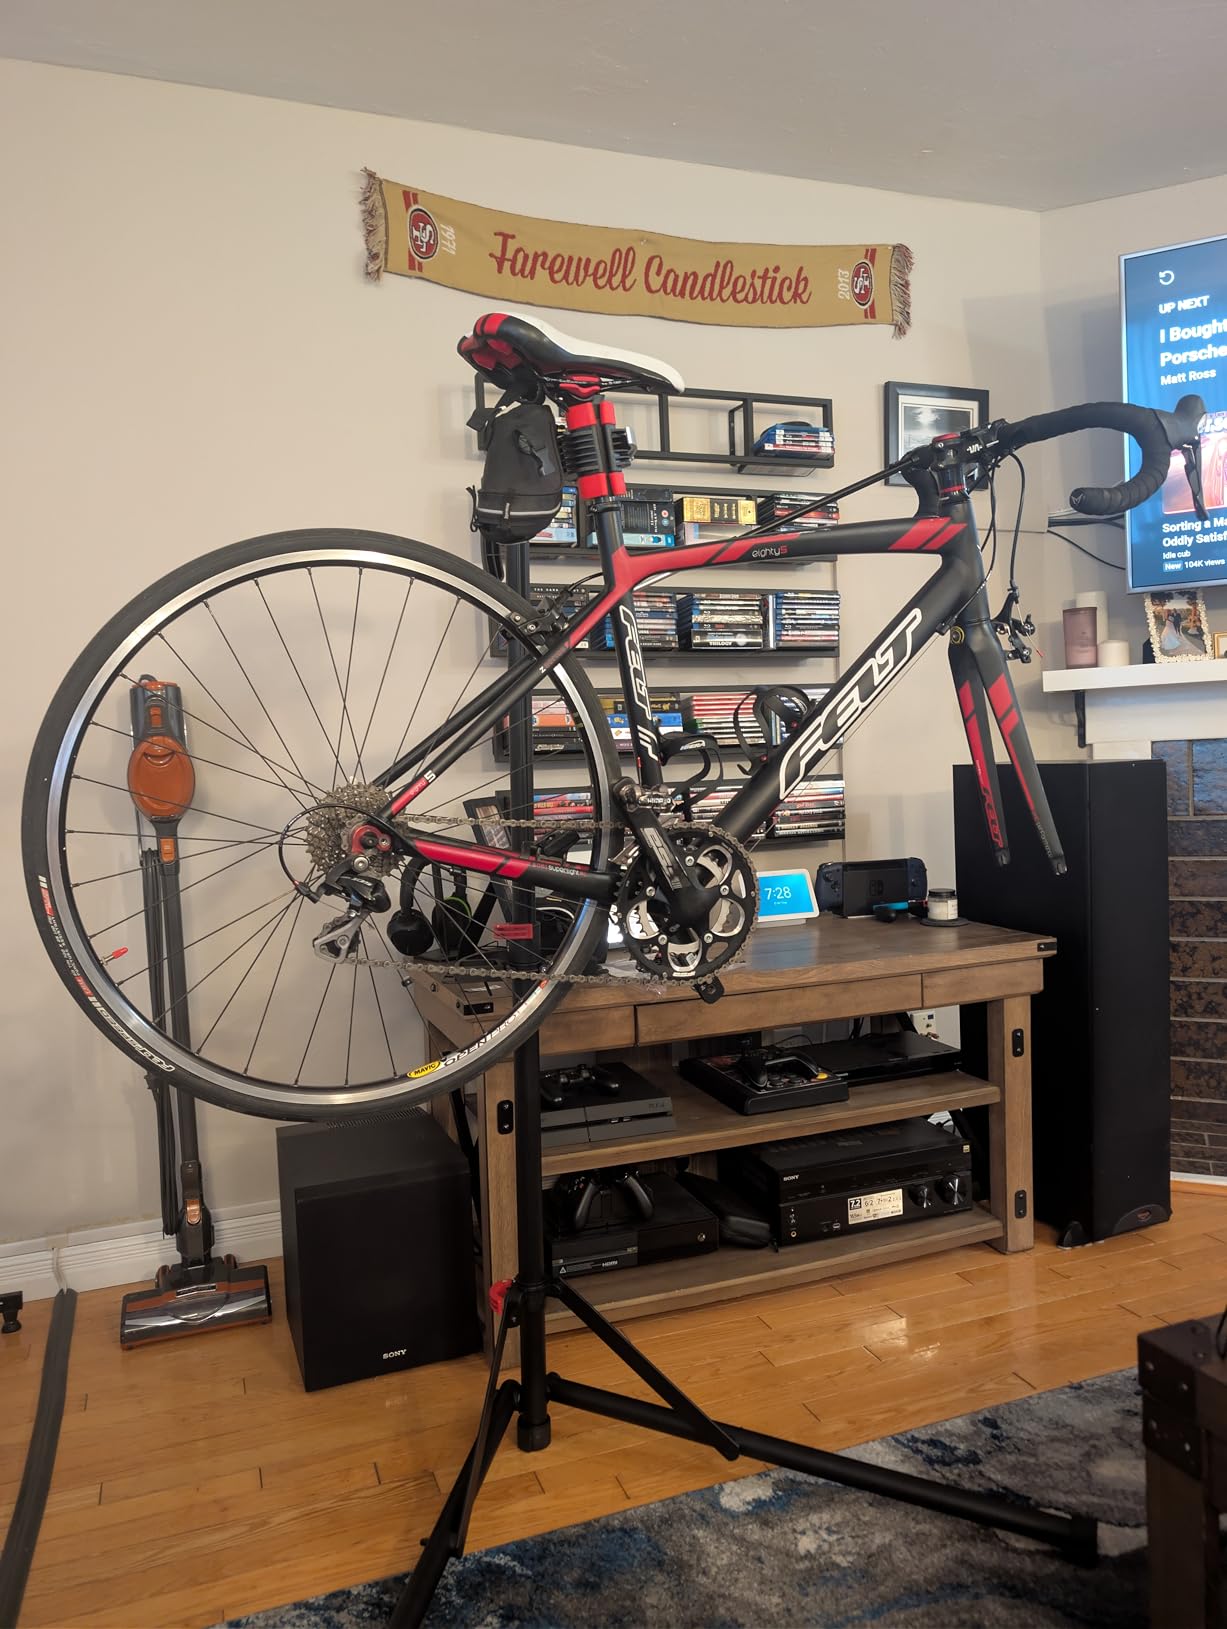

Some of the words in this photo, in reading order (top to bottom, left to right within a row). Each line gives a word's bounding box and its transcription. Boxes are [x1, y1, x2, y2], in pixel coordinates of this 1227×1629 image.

[439, 223, 456, 255] 1971
[488, 231, 637, 292] Farewell
[644, 254, 812, 306] Candlestick
[838, 268, 851, 301] 2013
[1158, 302, 1176, 314] UP
[1177, 295, 1210, 311] NEXT
[1159, 329, 1165, 343] I
[1169, 318, 1227, 342] Bought
[1160, 343, 1227, 367] Porsche
[1160, 372, 1187, 385] Matt
[1188, 368, 1216, 382] Ross
[1162, 519, 1201, 533] Sorting
[1203, 520, 1211, 529] a
[1162, 534, 1193, 548] Oddly
[1178, 549, 1191, 559] cub
[1165, 562, 1182, 571] New
[1184, 560, 1204, 569] 104K
[1204, 557, 1225, 567] views
[778, 606, 923, 801] FELT
[763, 886, 792, 901] 7:28
[413, 1062, 436, 1076] MAVIC
[783, 1174, 800, 1182] SONY
[382, 1348, 408, 1360] SONY
